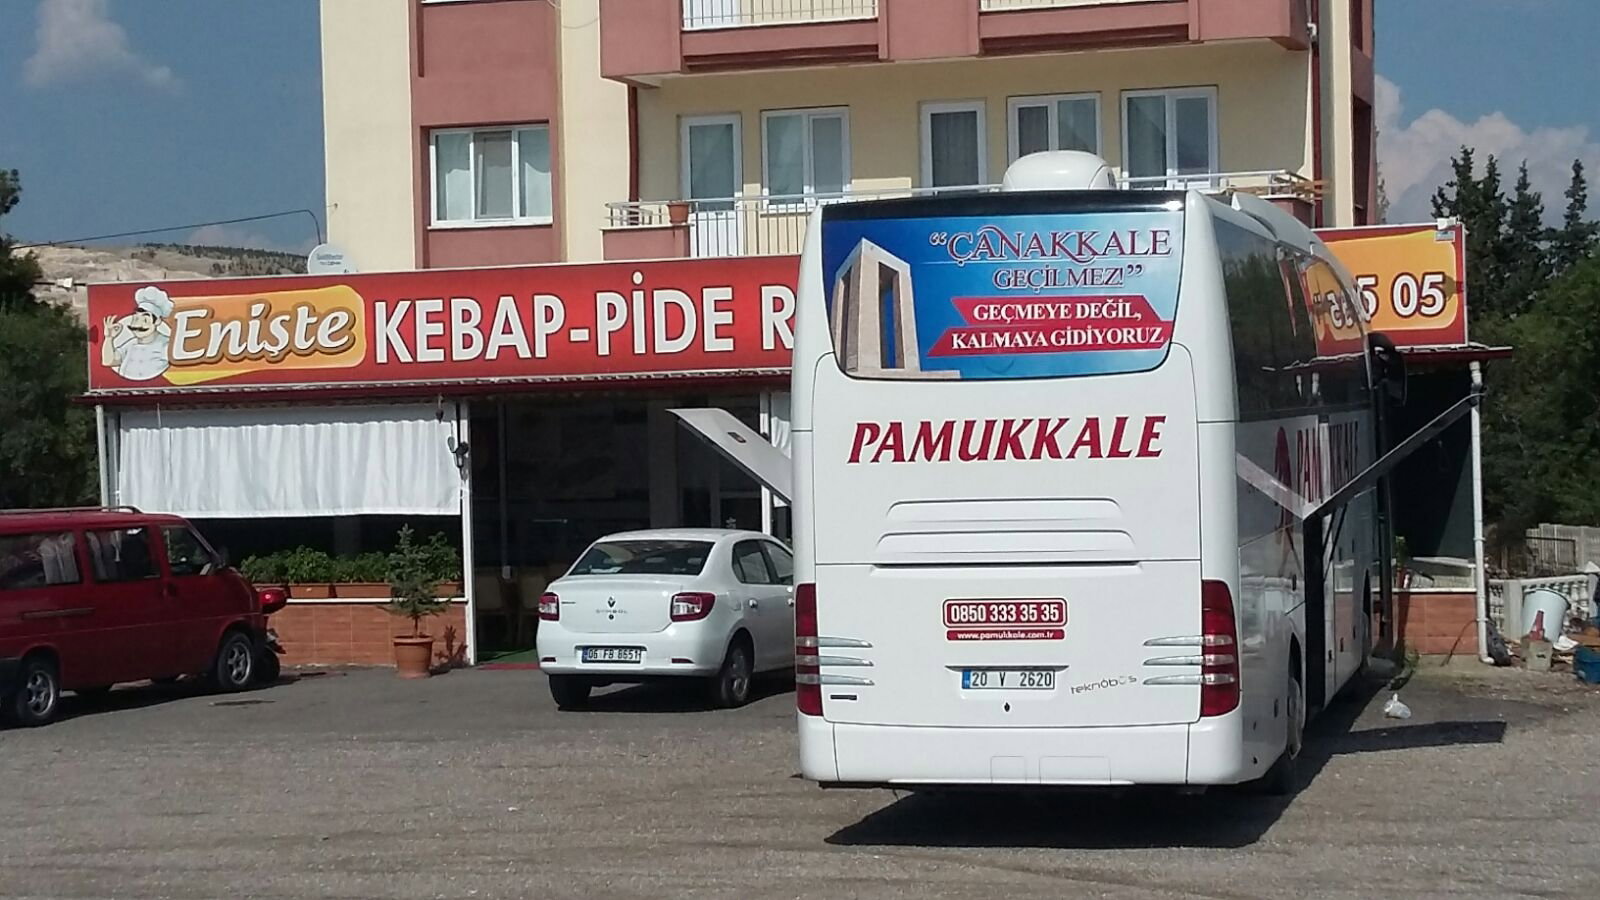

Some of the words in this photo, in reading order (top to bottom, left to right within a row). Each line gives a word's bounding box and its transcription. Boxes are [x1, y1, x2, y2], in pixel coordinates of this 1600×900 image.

[1392, 273, 1446, 317] 05
[373, 270, 735, 364] KEBAP-PİDE
[973, 302, 1072, 324] GEÇMEYE
[1075, 298, 1142, 321] DEĞİL,
[171, 302, 351, 360] Enişte
[951, 332, 1048, 350] KALMAYA
[1050, 326, 1165, 346] GİDİYORUZ
[846, 415, 1167, 464] PAMUKKALE
[950, 604, 987, 622] 0850
[989, 604, 1017, 622] 333
[1019, 604, 1038, 621] 35
[1040, 603, 1060, 621] 35
[957, 630, 1054, 640] www.pamukkale.com.tr
[972, 672, 988, 687] 20
[999, 672, 1006, 687] V
[1019, 672, 1052, 687] 2620
